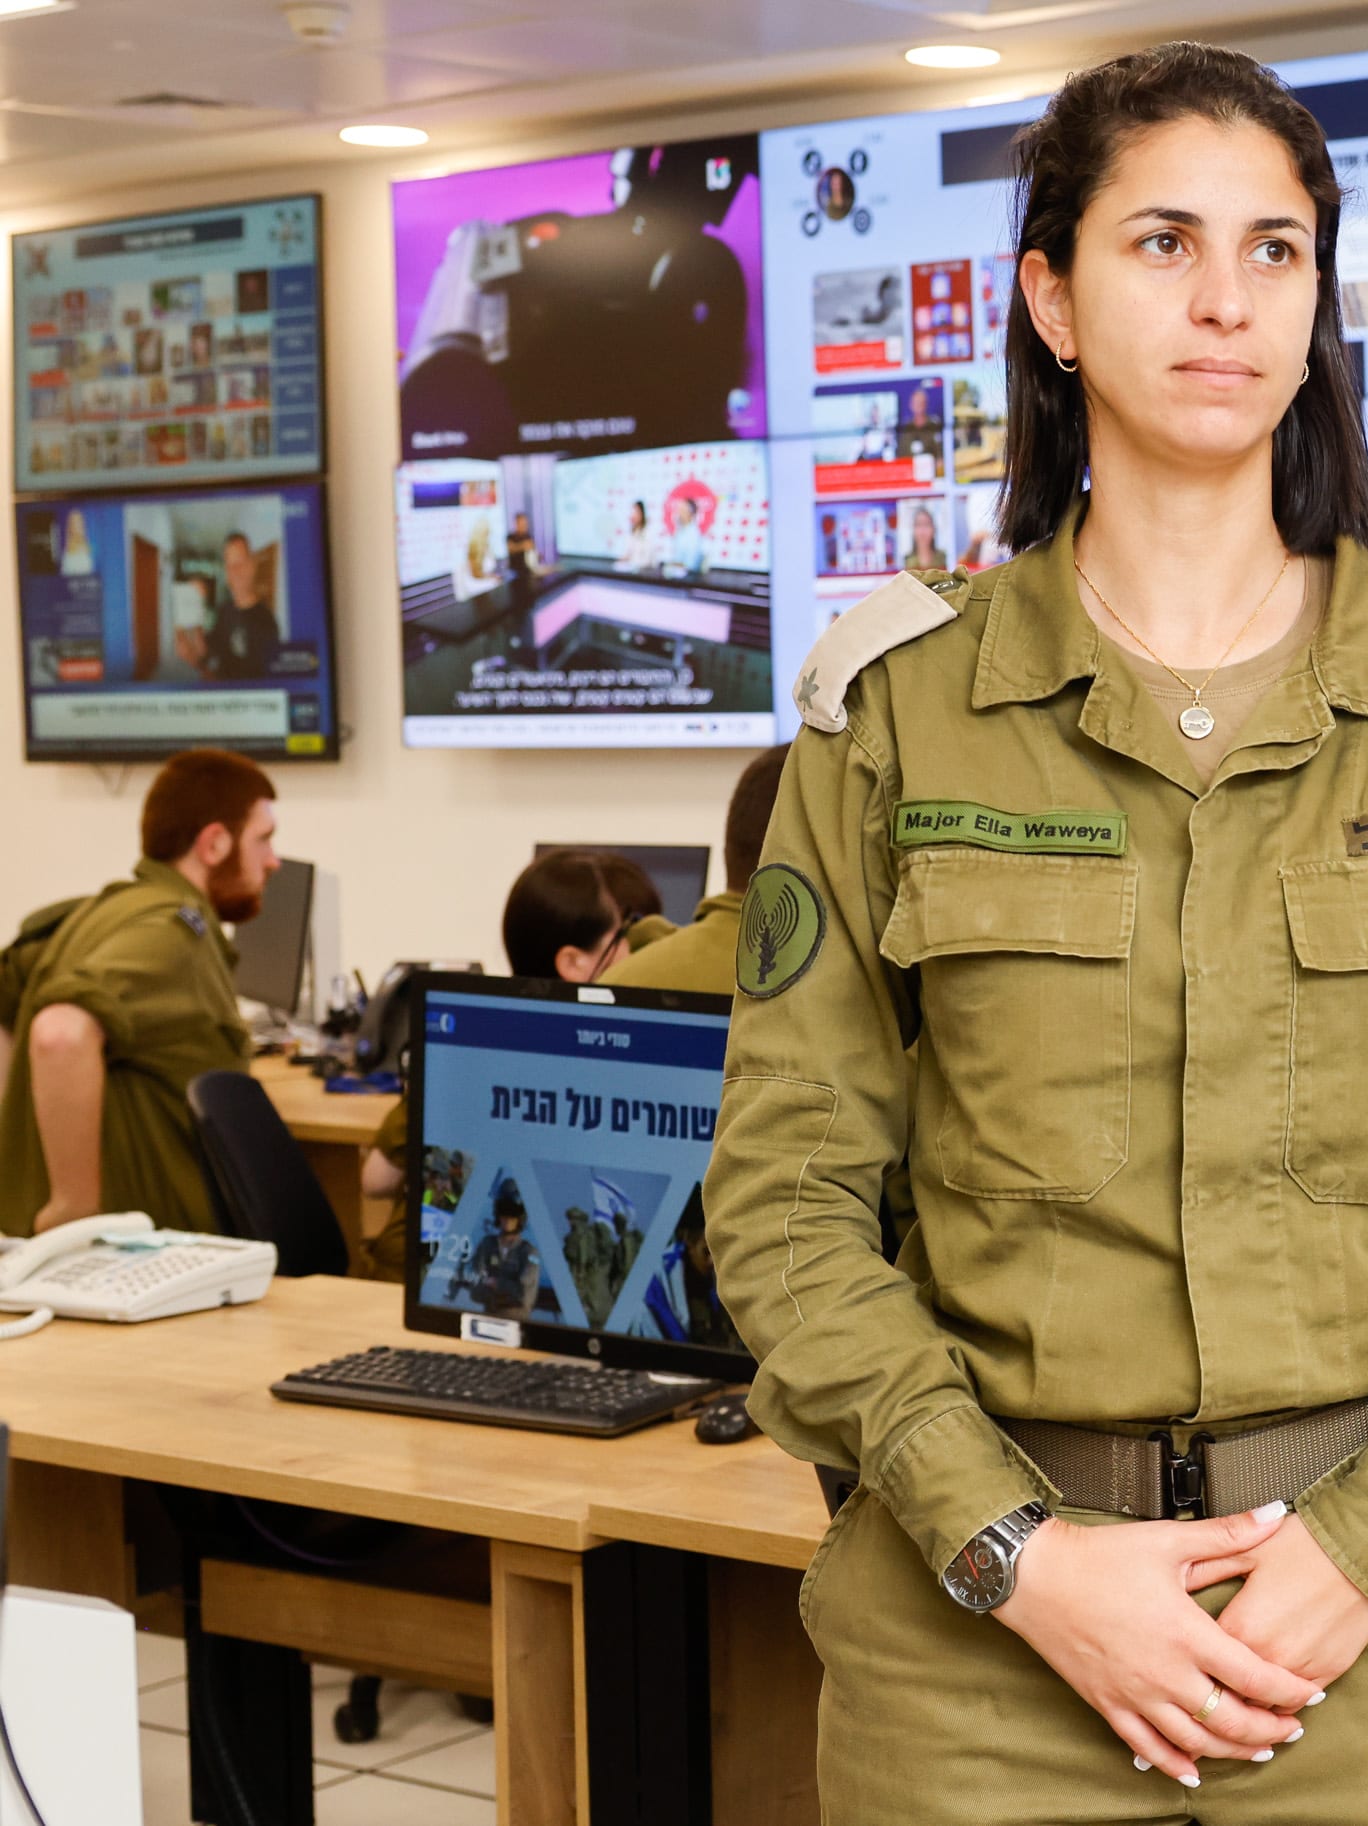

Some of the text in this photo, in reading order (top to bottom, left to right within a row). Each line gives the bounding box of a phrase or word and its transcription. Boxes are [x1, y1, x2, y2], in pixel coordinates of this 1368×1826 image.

[905, 811, 1112, 842] Major Ella Waweya
[491, 1084, 717, 1142] שומרים על הבית
